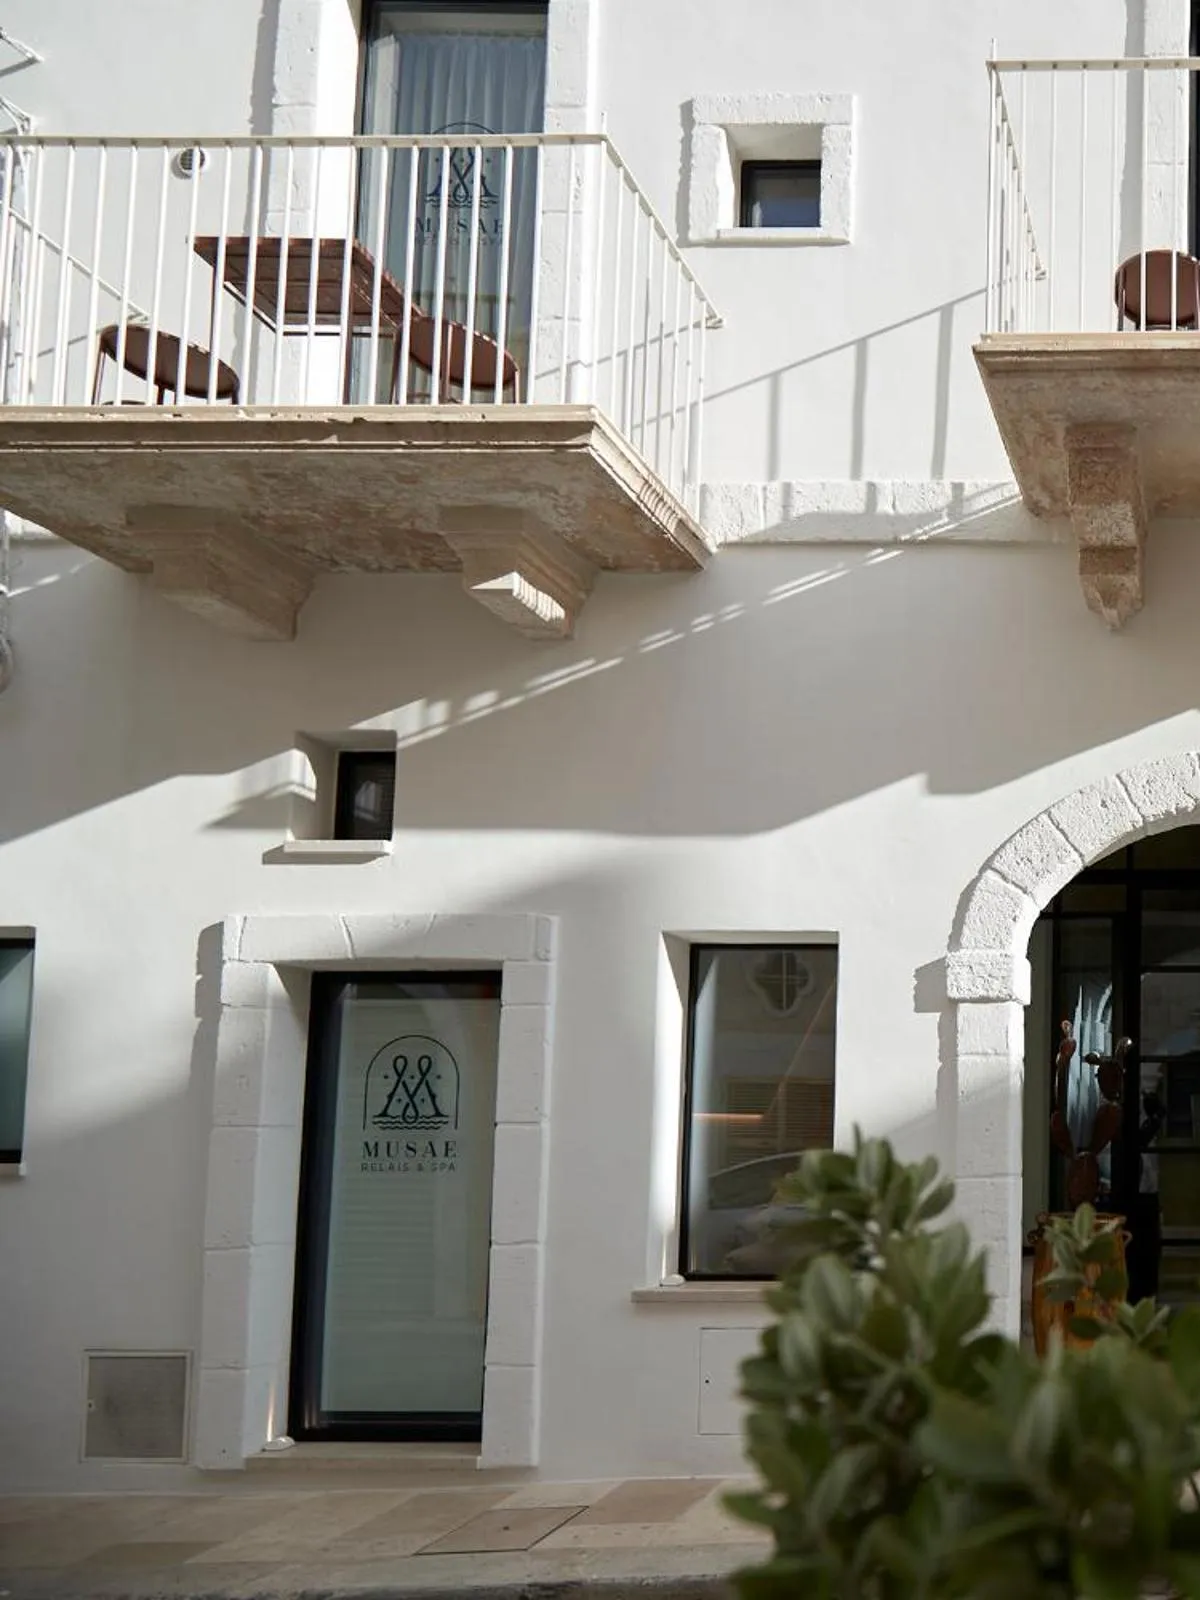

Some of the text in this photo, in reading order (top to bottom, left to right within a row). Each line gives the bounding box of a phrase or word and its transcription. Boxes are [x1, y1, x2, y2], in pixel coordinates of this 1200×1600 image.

[363, 1140, 457, 1158] MUSAE
[361, 1162, 410, 1172] RELAIS
[431, 1162, 456, 1172] SPA
